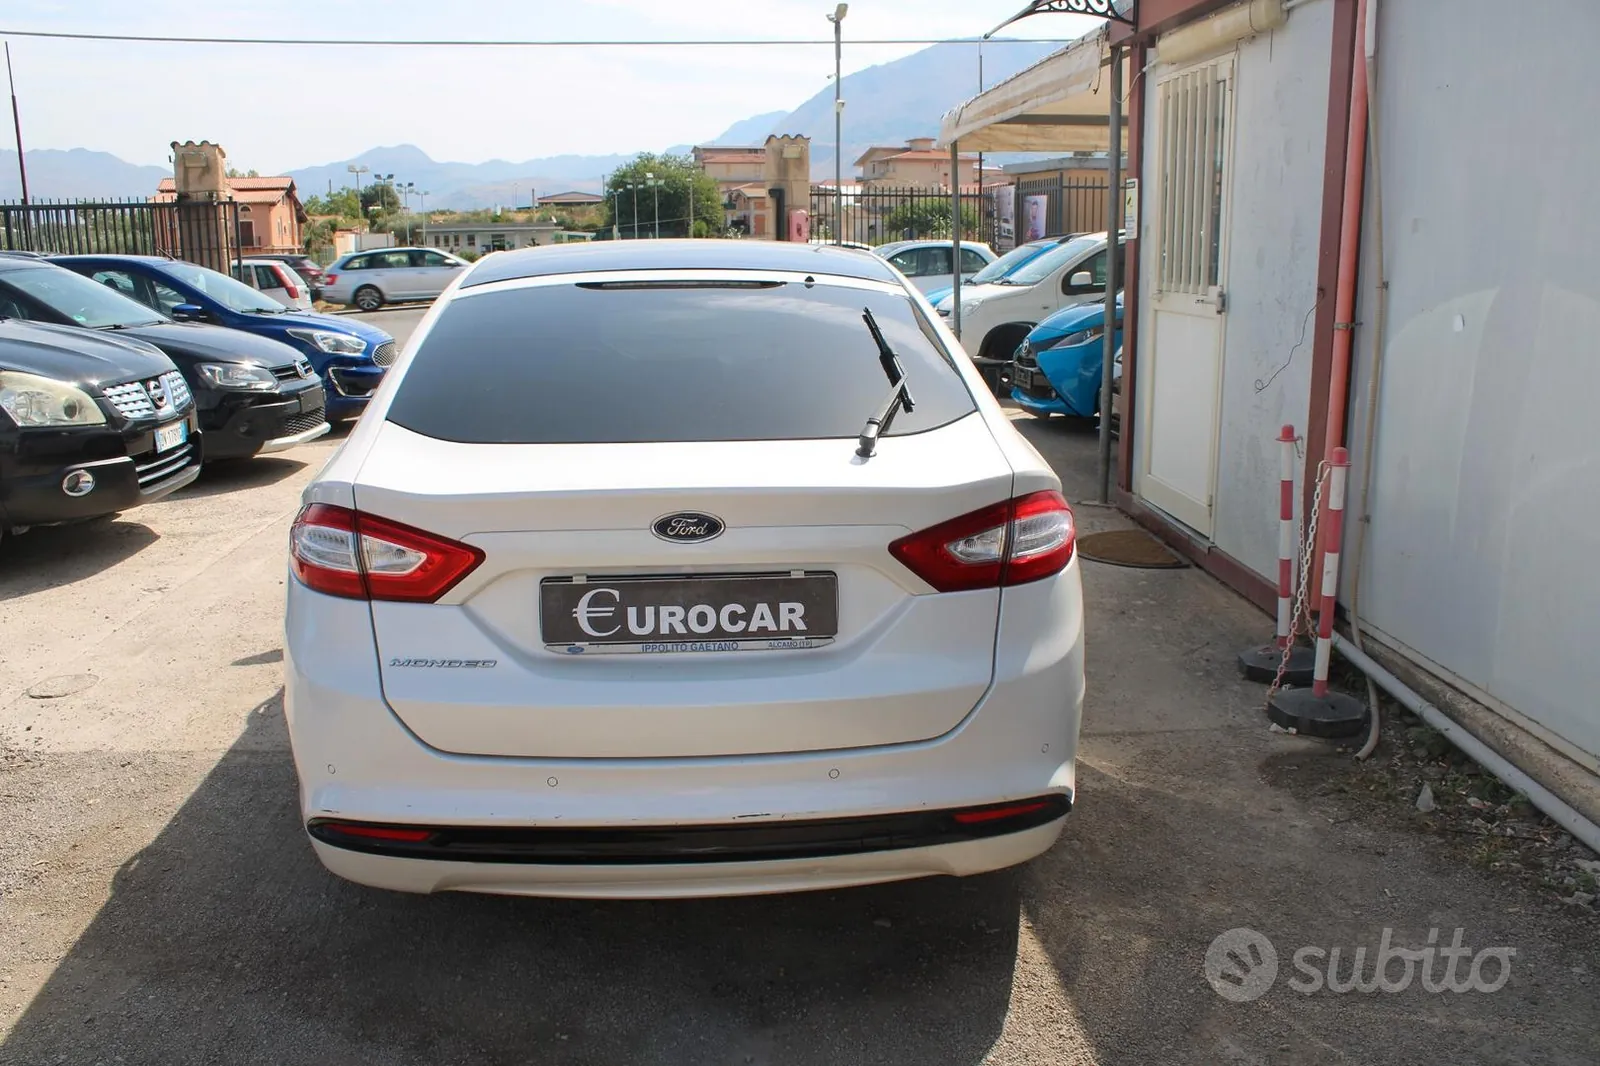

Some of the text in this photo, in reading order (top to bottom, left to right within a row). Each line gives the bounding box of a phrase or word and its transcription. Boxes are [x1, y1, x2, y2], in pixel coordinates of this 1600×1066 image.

[667, 517, 709, 536] Ford
[641, 641, 739, 653] IPPOLITO GAETANO
[768, 639, 797, 648] ALCAMO
[389, 659, 498, 668] MONDEO
